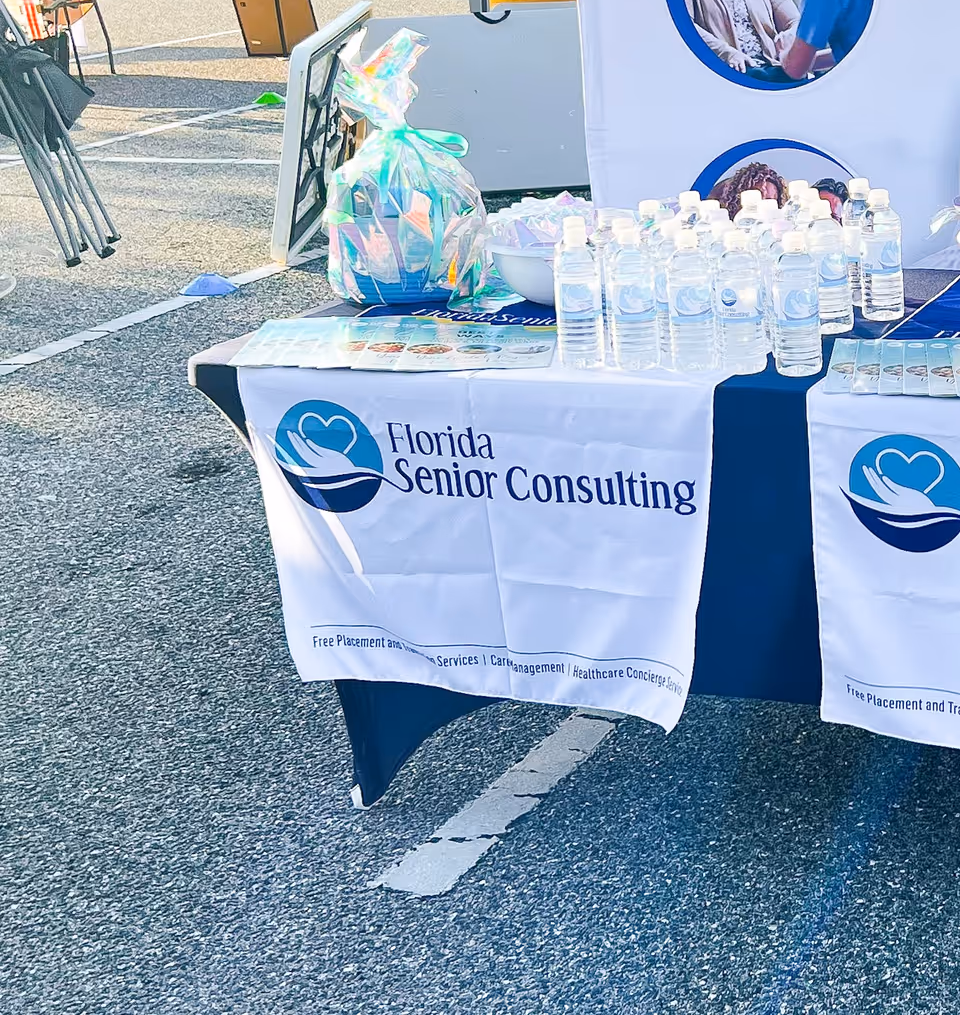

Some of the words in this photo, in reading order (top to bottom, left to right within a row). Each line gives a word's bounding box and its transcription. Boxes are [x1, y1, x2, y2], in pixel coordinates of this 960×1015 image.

[386, 422, 495, 459] Florida
[394, 458, 498, 500] Senior
[505, 466, 698, 516] Consulting
[312, 635, 334, 649] Free
[337, 634, 386, 649] Placement
[437, 654, 479, 668] Services
[572, 664, 624, 680] Healthcare
[626, 666, 666, 687] Concierge
[846, 684, 865, 702] Free
[867, 693, 923, 711] Placement
[925, 699, 945, 713] and
